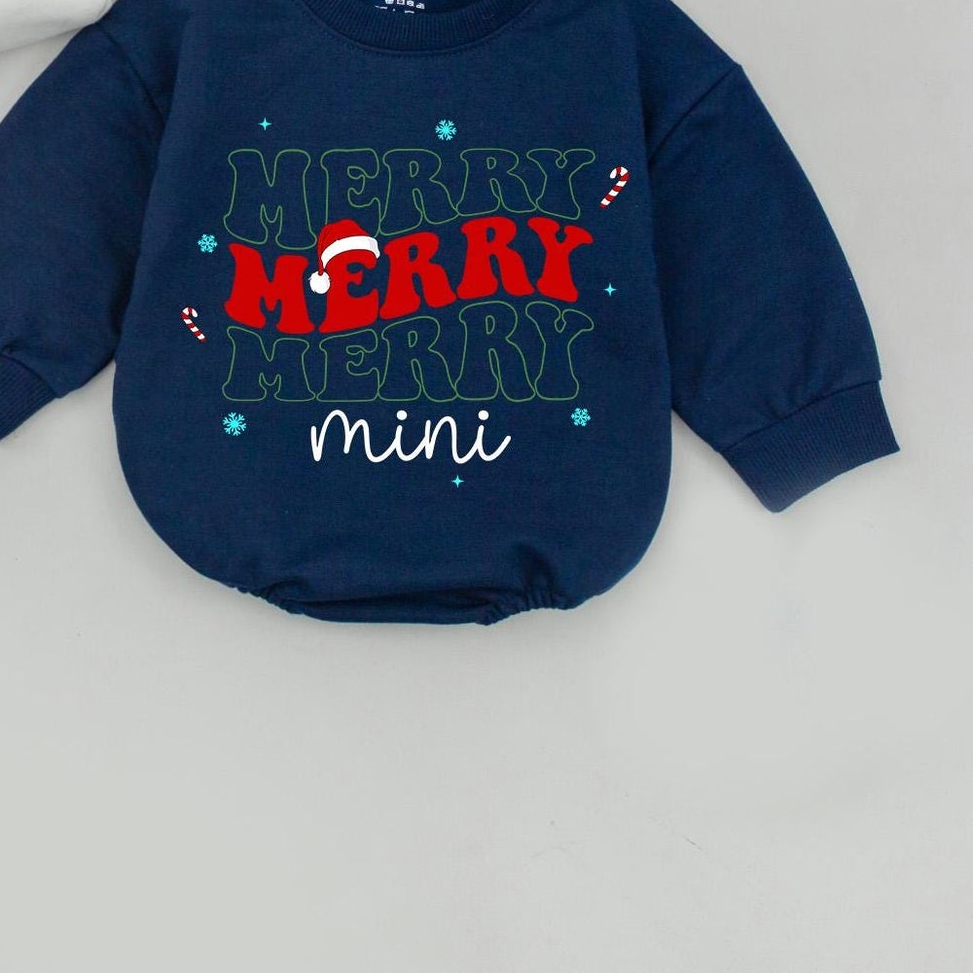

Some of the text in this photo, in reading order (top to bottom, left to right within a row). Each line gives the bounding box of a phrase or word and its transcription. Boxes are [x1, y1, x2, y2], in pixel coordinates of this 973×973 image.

[223, 148, 596, 250] MERRY
[224, 216, 594, 334] MERRY
[222, 301, 594, 402] MERRY
[310, 409, 512, 464] mini
